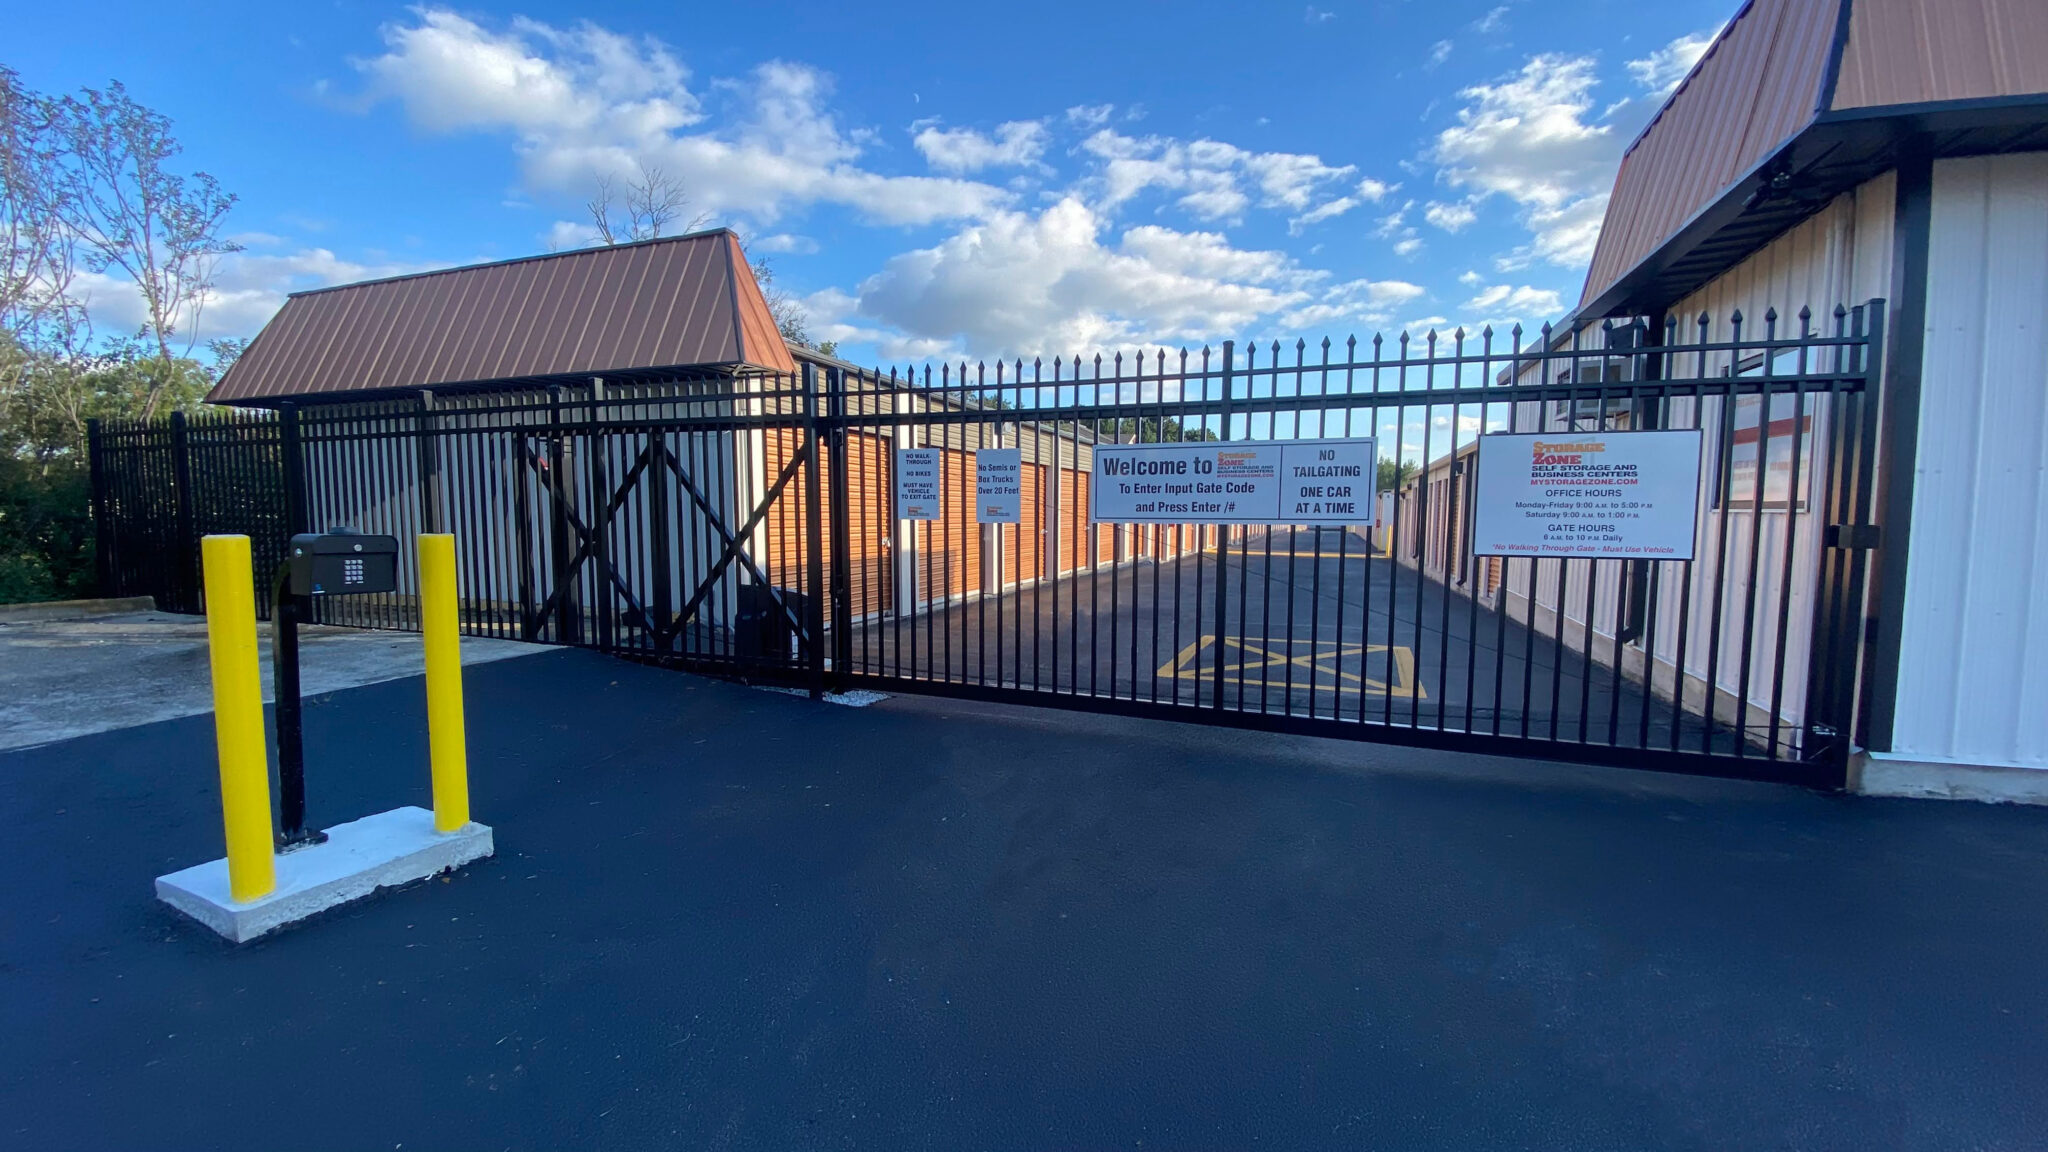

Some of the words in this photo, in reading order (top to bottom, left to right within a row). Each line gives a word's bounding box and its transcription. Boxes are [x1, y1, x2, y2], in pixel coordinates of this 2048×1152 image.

[1533, 442, 1605, 453] STORAGE
[1319, 450, 1335, 461] NO
[1533, 453, 1582, 465] ZONE
[1104, 457, 1186, 475] Welcome
[1194, 456, 1212, 475] to
[1293, 466, 1360, 478] TAILGATING
[1119, 483, 1131, 494] To
[1134, 483, 1163, 494] Enter
[1165, 483, 1193, 495] Input
[1196, 482, 1222, 494] Gate
[1226, 482, 1254, 493] Code
[1300, 487, 1322, 497] ONE
[1327, 487, 1351, 497] CAR
[1136, 502, 1155, 513] and
[1158, 502, 1188, 512] Press
[1192, 502, 1221, 512] Enter
[1224, 502, 1235, 513] /#
[1296, 503, 1310, 514] AT
[1313, 503, 1320, 513] A
[1325, 503, 1354, 514] TIME
[1508, 544, 1538, 552] Walking
